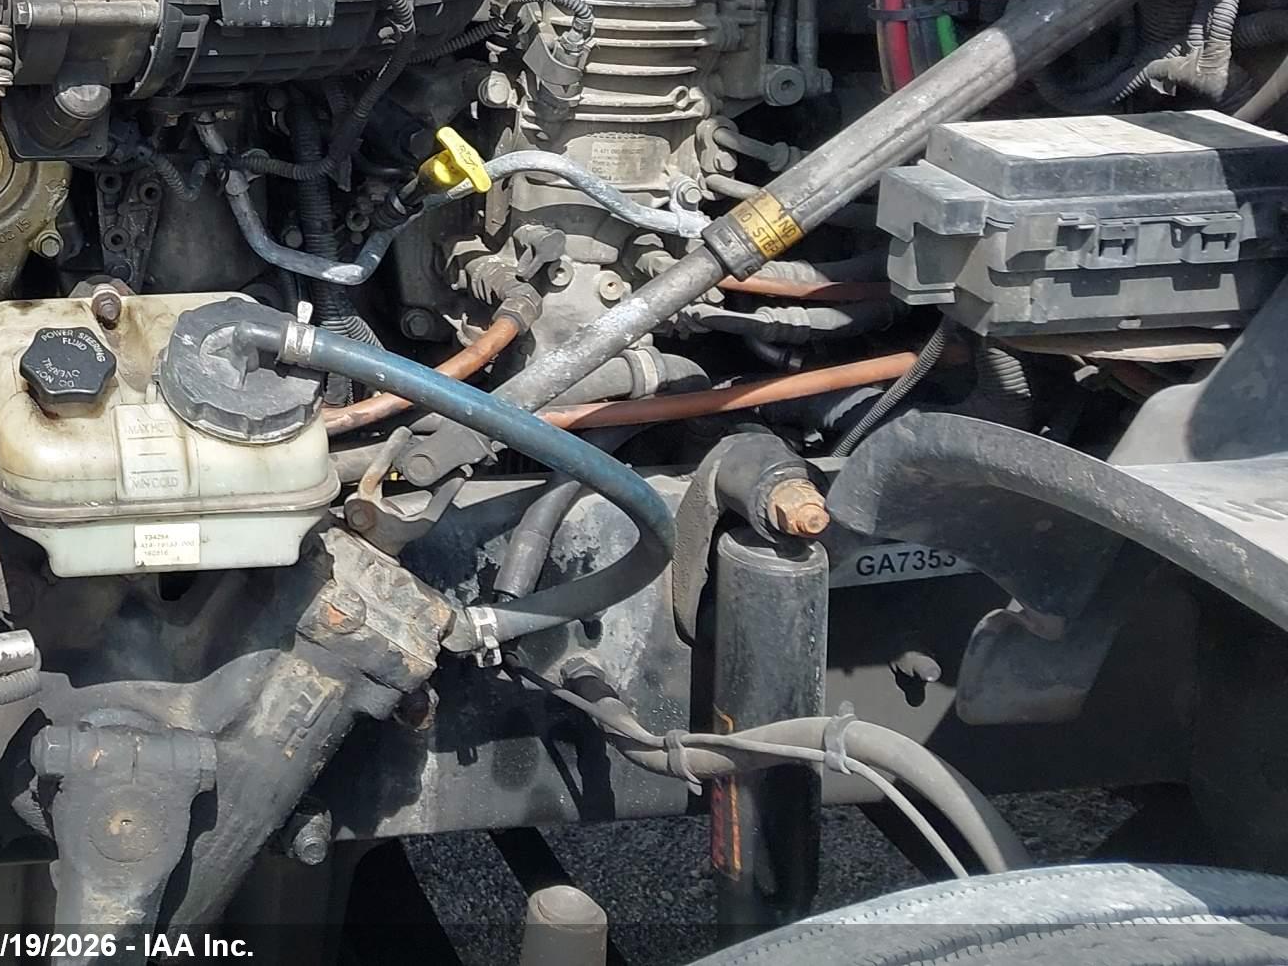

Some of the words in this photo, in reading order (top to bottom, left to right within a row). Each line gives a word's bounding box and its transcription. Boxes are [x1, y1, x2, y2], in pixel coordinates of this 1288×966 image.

[753, 226, 779, 253] STEP
[40, 329, 74, 342] POWER
[78, 332, 106, 363] STEERING
[62, 337, 88, 351] FLUID
[59, 379, 75, 388] DO
